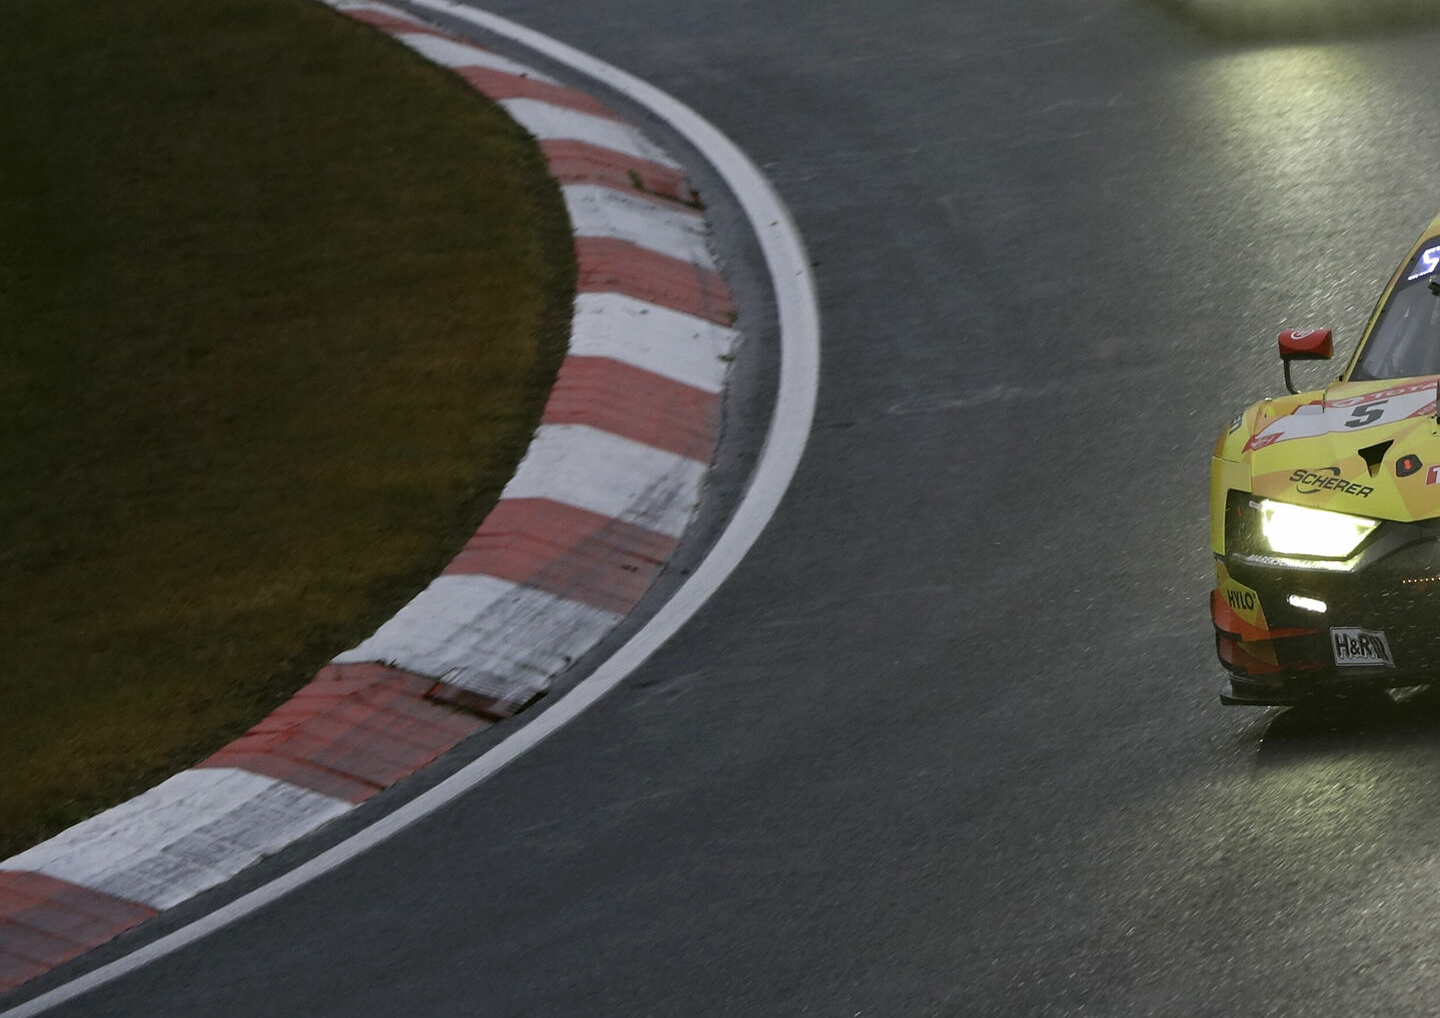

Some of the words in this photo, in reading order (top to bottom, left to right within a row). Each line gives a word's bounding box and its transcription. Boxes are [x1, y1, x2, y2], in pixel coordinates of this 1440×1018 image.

[1344, 399, 1388, 429] 5
[1289, 467, 1375, 499] SCHERER
[1227, 589, 1255, 611] HYLO
[1335, 632, 1375, 660] H&R
